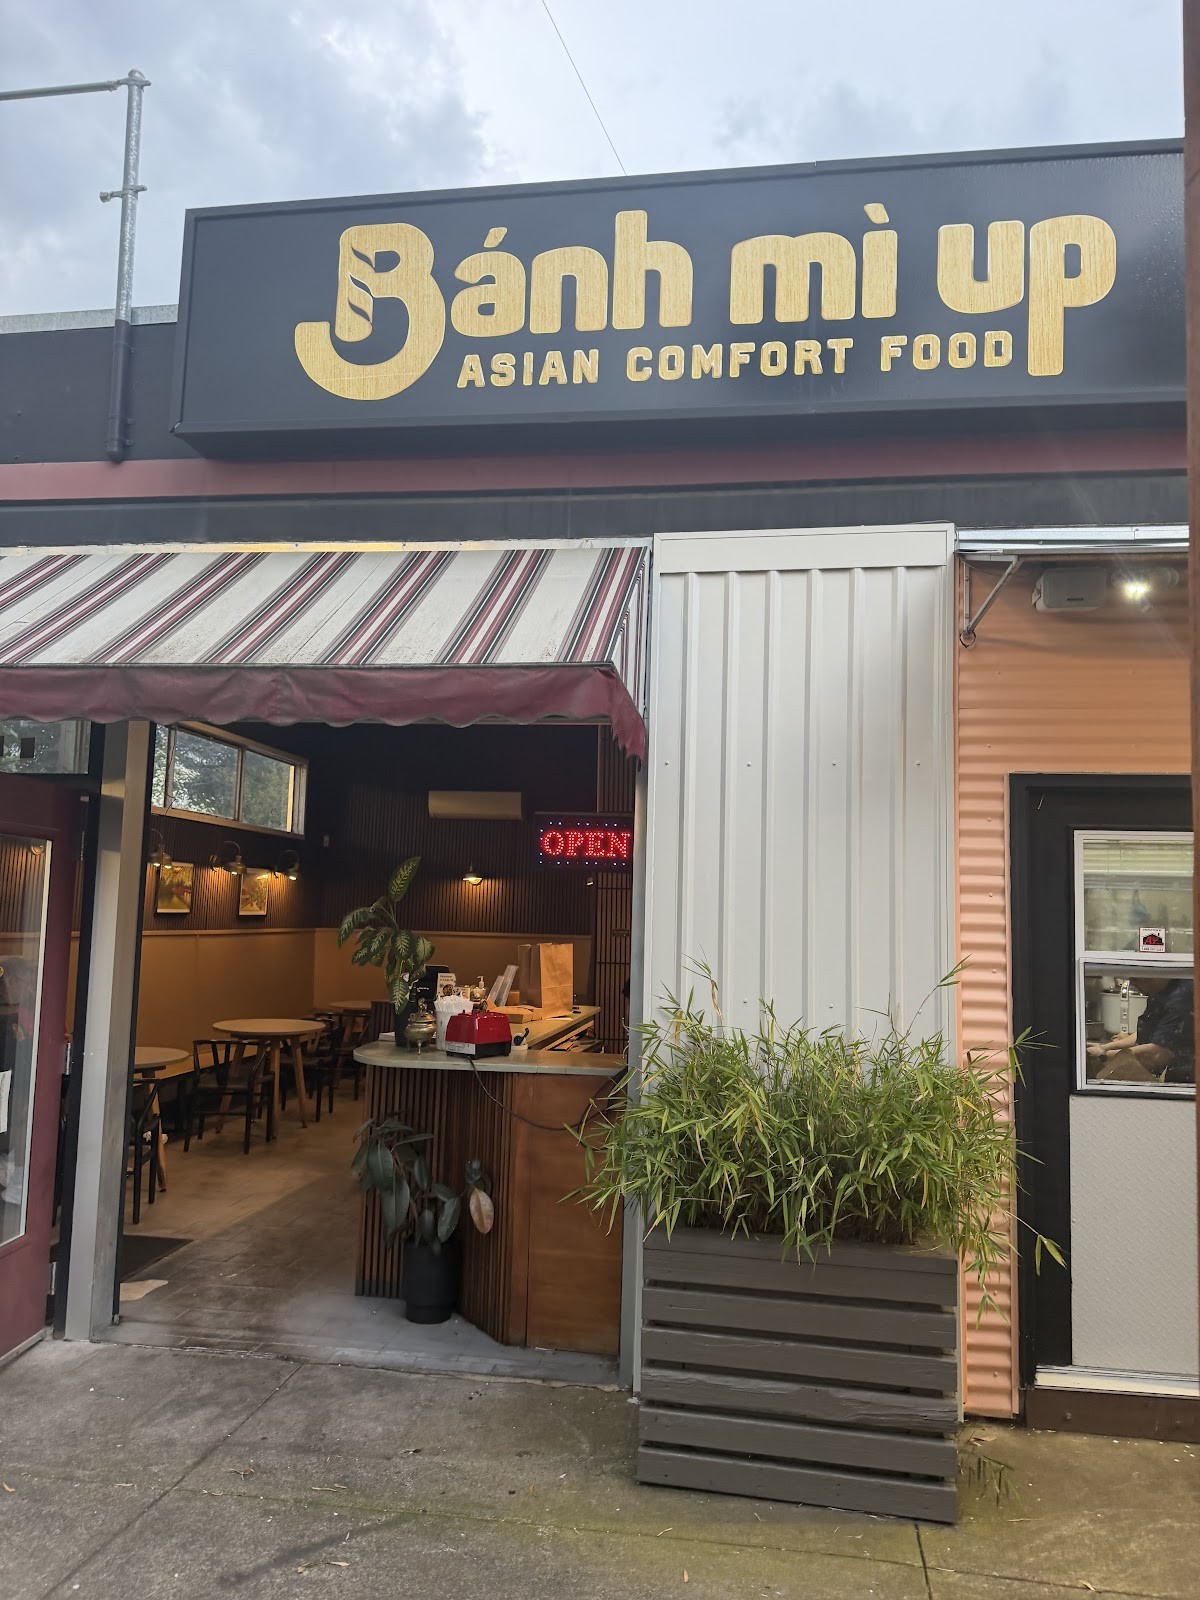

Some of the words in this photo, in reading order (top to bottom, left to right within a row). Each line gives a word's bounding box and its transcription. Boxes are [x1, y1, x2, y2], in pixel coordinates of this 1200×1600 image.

[294, 210, 693, 401] Bánh
[729, 203, 898, 325] mì
[936, 214, 1118, 377] up
[456, 349, 599, 390] ASIAN
[626, 337, 854, 382] COMFORT
[880, 330, 1013, 372] FOOD
[542, 830, 631, 858] OPEN
